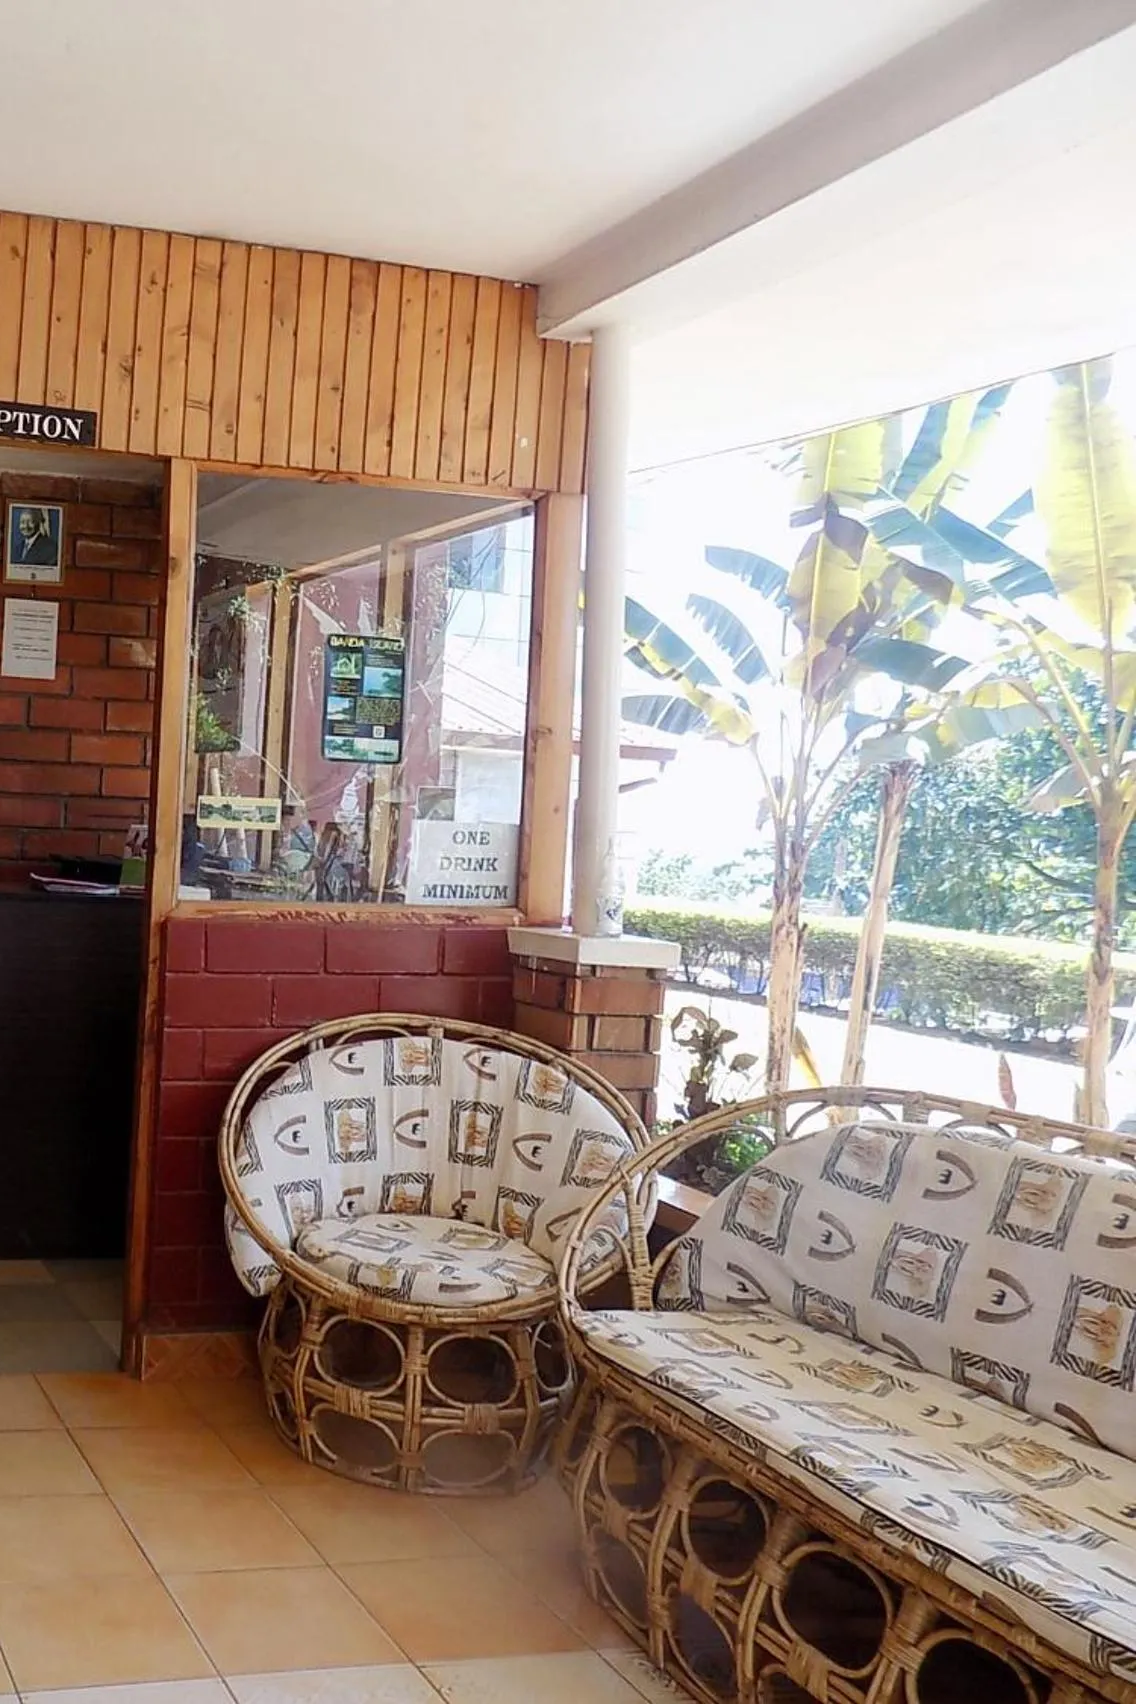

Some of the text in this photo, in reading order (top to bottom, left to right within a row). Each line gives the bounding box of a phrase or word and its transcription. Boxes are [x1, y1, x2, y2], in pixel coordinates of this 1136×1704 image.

[452, 830, 491, 846] ONE
[439, 856, 499, 872] DRINK
[422, 884, 509, 900] MINIMUM
